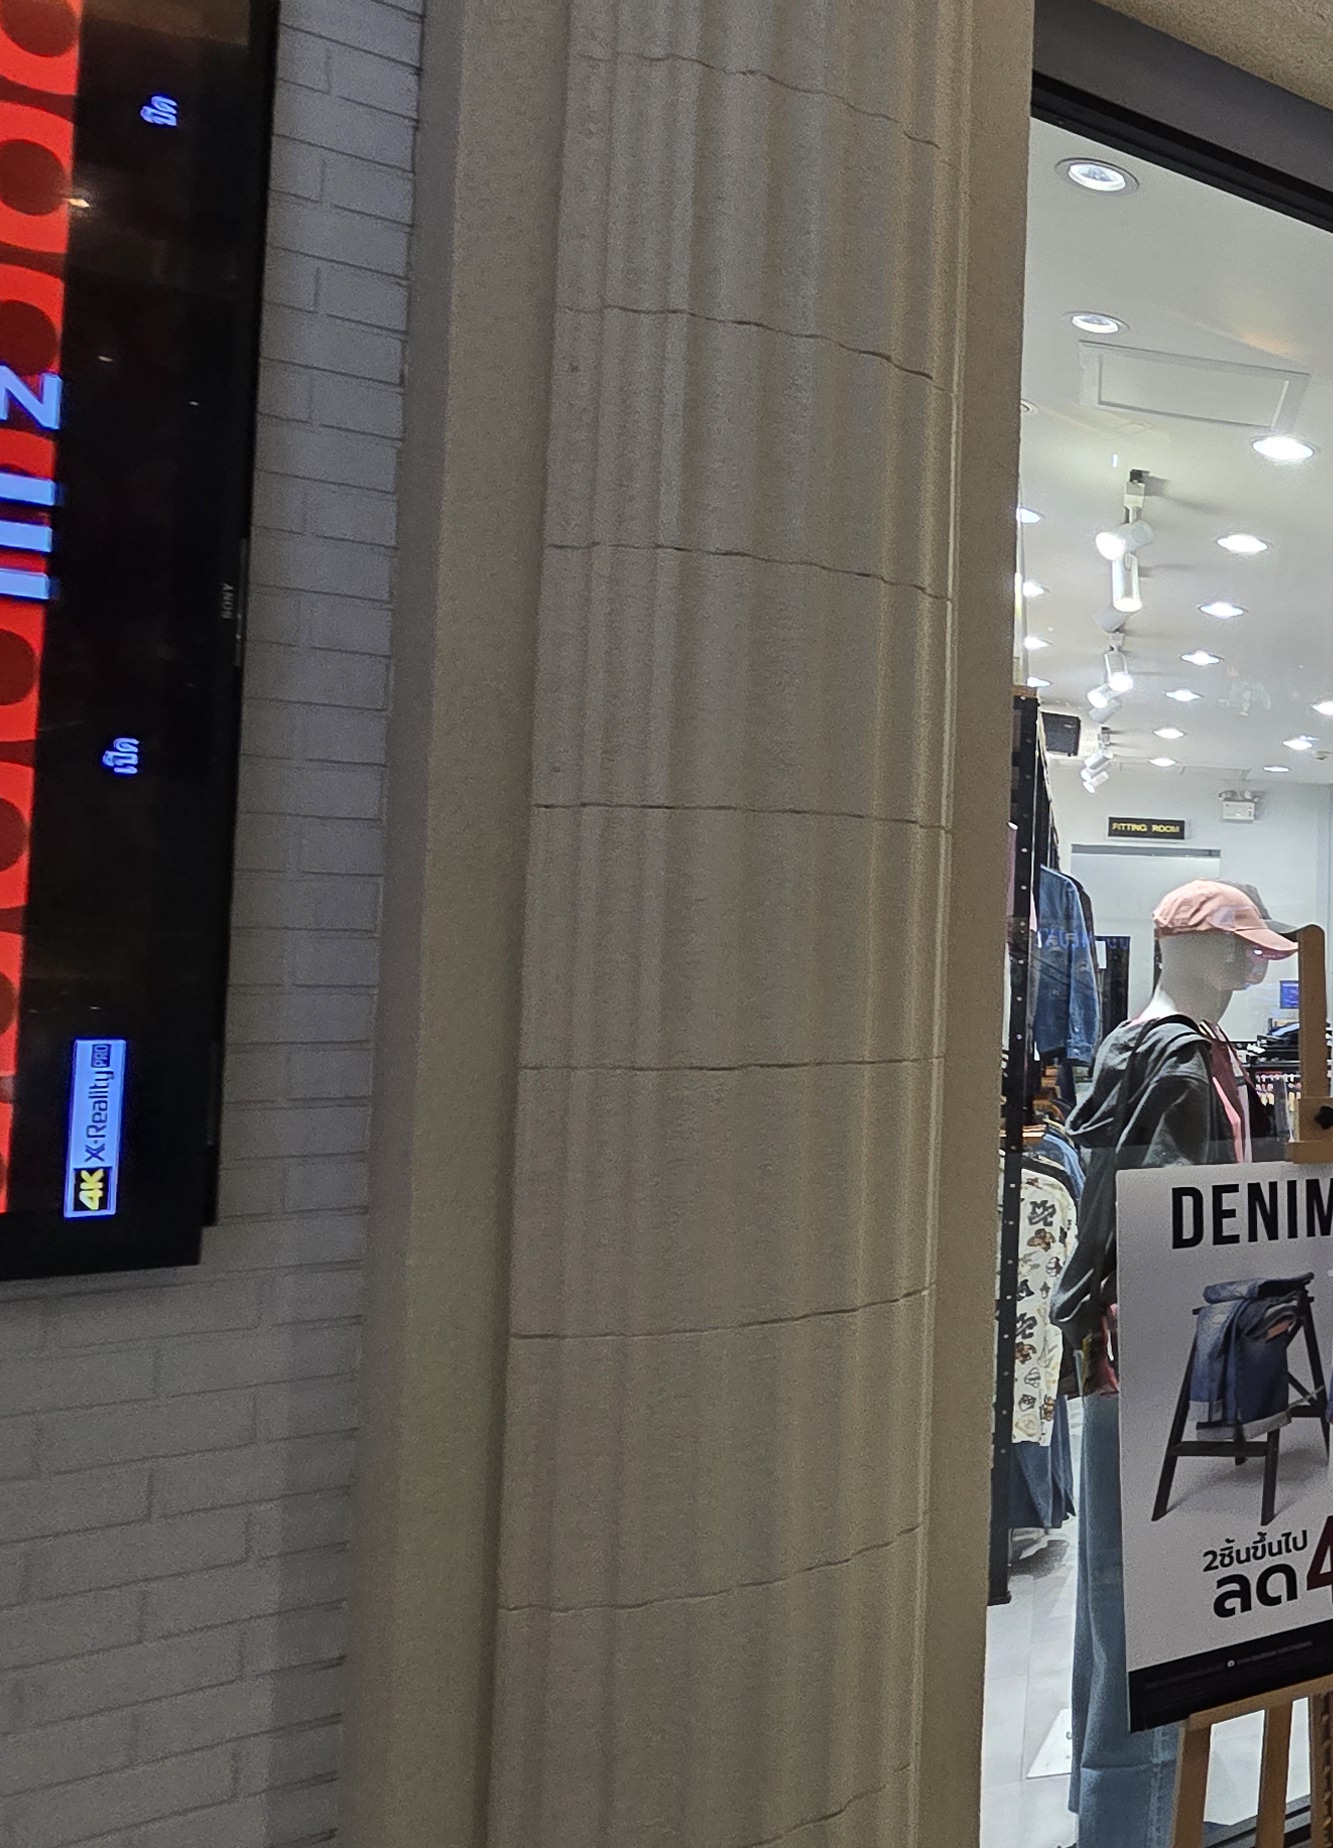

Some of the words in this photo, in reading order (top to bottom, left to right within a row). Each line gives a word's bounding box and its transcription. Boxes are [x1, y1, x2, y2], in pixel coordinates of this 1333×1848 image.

[220, 582, 234, 620] SONY
[102, 737, 140, 775] เปิด
[1112, 822, 1148, 832] FITTING
[1151, 824, 1180, 833] ROOM
[79, 1167, 105, 1211] 4K
[1212, 1563, 1299, 1619] ลด
